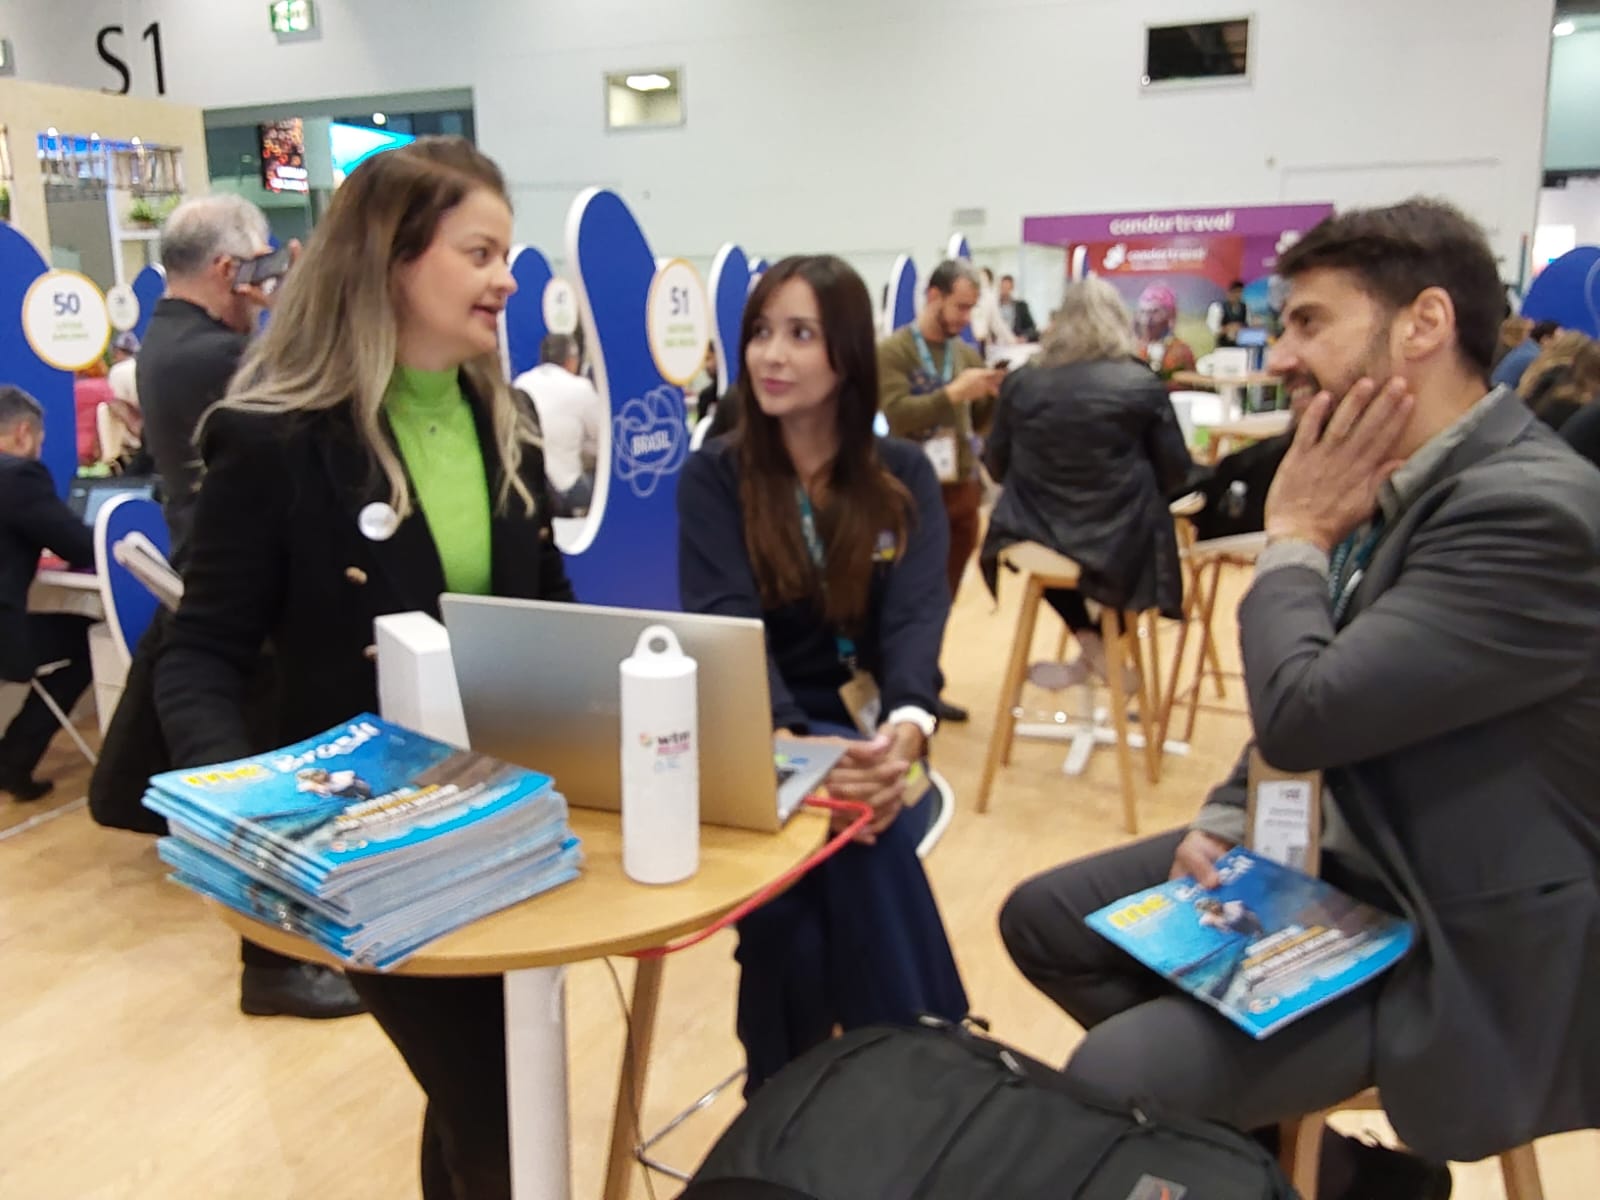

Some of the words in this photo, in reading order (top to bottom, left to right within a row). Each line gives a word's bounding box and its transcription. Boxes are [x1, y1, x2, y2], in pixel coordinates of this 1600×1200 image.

[1109, 211, 1236, 236] condortravel
[53, 291, 81, 316] 50
[671, 286, 690, 316] 51
[631, 430, 673, 457] BRASIL
